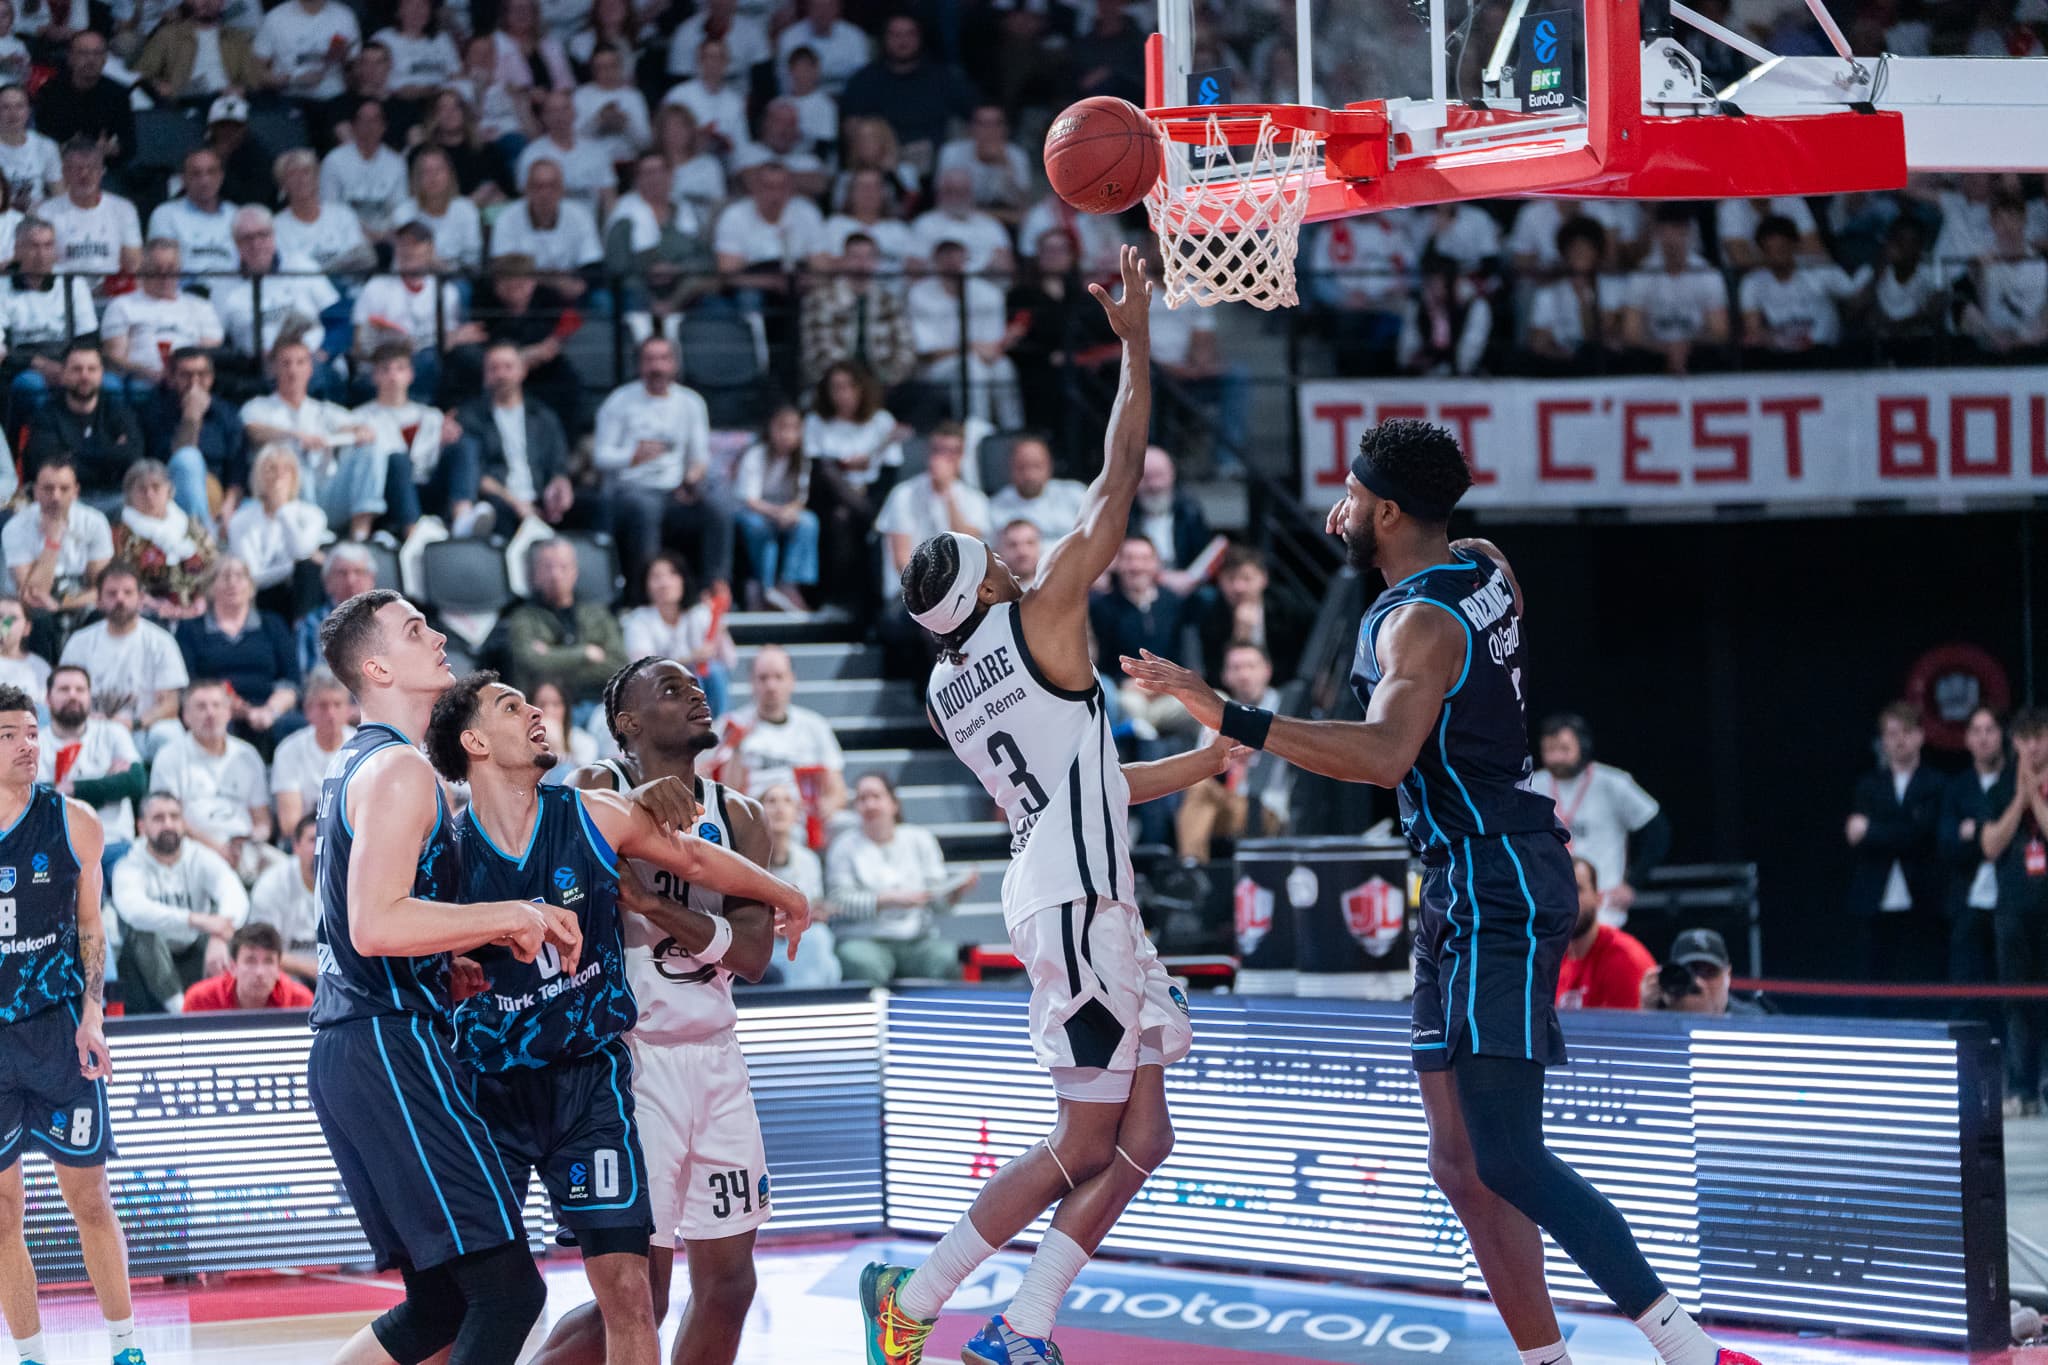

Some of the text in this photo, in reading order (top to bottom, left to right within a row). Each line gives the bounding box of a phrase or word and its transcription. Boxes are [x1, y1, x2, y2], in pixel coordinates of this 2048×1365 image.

[1529, 91, 1565, 107] EuroCup
[1531, 71, 1561, 87] BKT
[1314, 394, 2048, 486] II C'EST BO
[936, 646, 1015, 720] MOULARE
[954, 716, 986, 743] Charles
[986, 730, 1050, 815] 3
[563, 887, 579, 898] BKT
[563, 893, 585, 905] EuroCup
[0, 933, 57, 954] elekom
[495, 961, 601, 1013] Türk Telekom
[71, 1108, 93, 1146] 8
[594, 1149, 620, 1198] 0
[708, 1169, 752, 1219] 34
[1067, 1284, 1451, 1355] motorola
